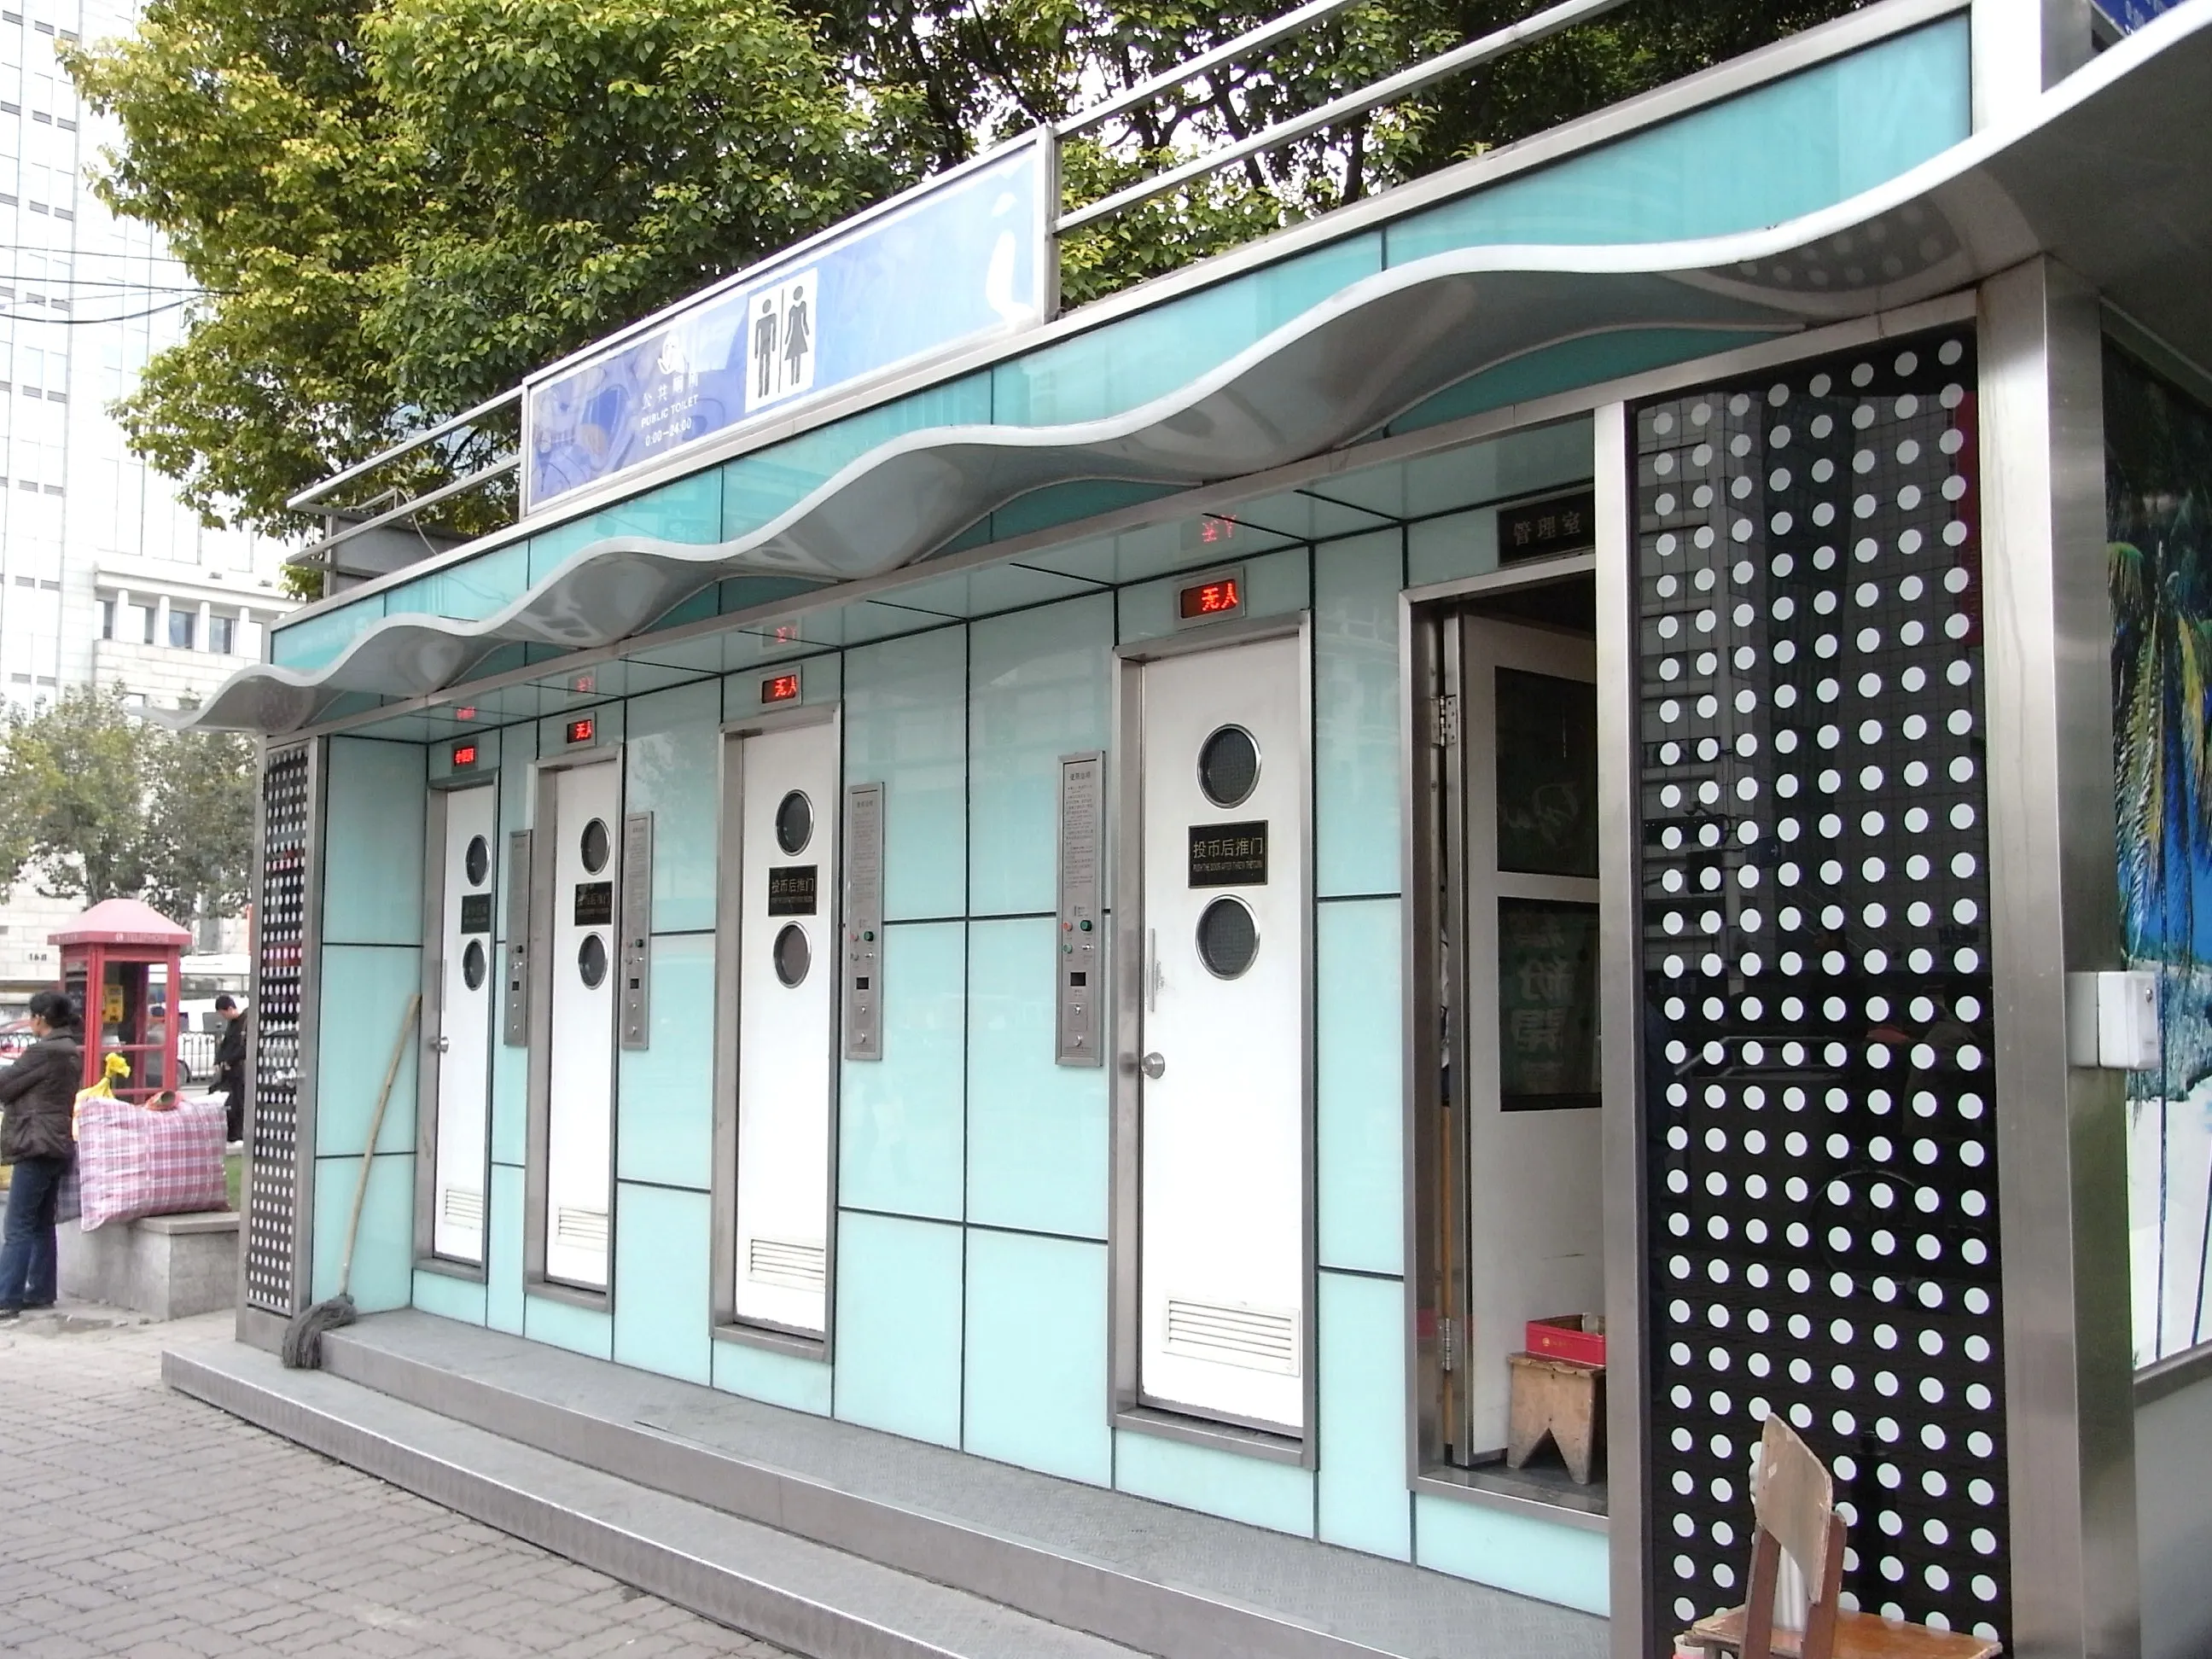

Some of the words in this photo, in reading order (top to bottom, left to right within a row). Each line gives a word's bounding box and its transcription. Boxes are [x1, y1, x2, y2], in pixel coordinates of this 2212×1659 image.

[641, 408, 668, 428] PUBLIC
[671, 394, 698, 415] TOILET
[1513, 510, 1580, 546] 管理室
[1202, 583, 1237, 611] 无人
[775, 676, 797, 697] 无人
[1193, 836, 1263, 859] 投币后推门
